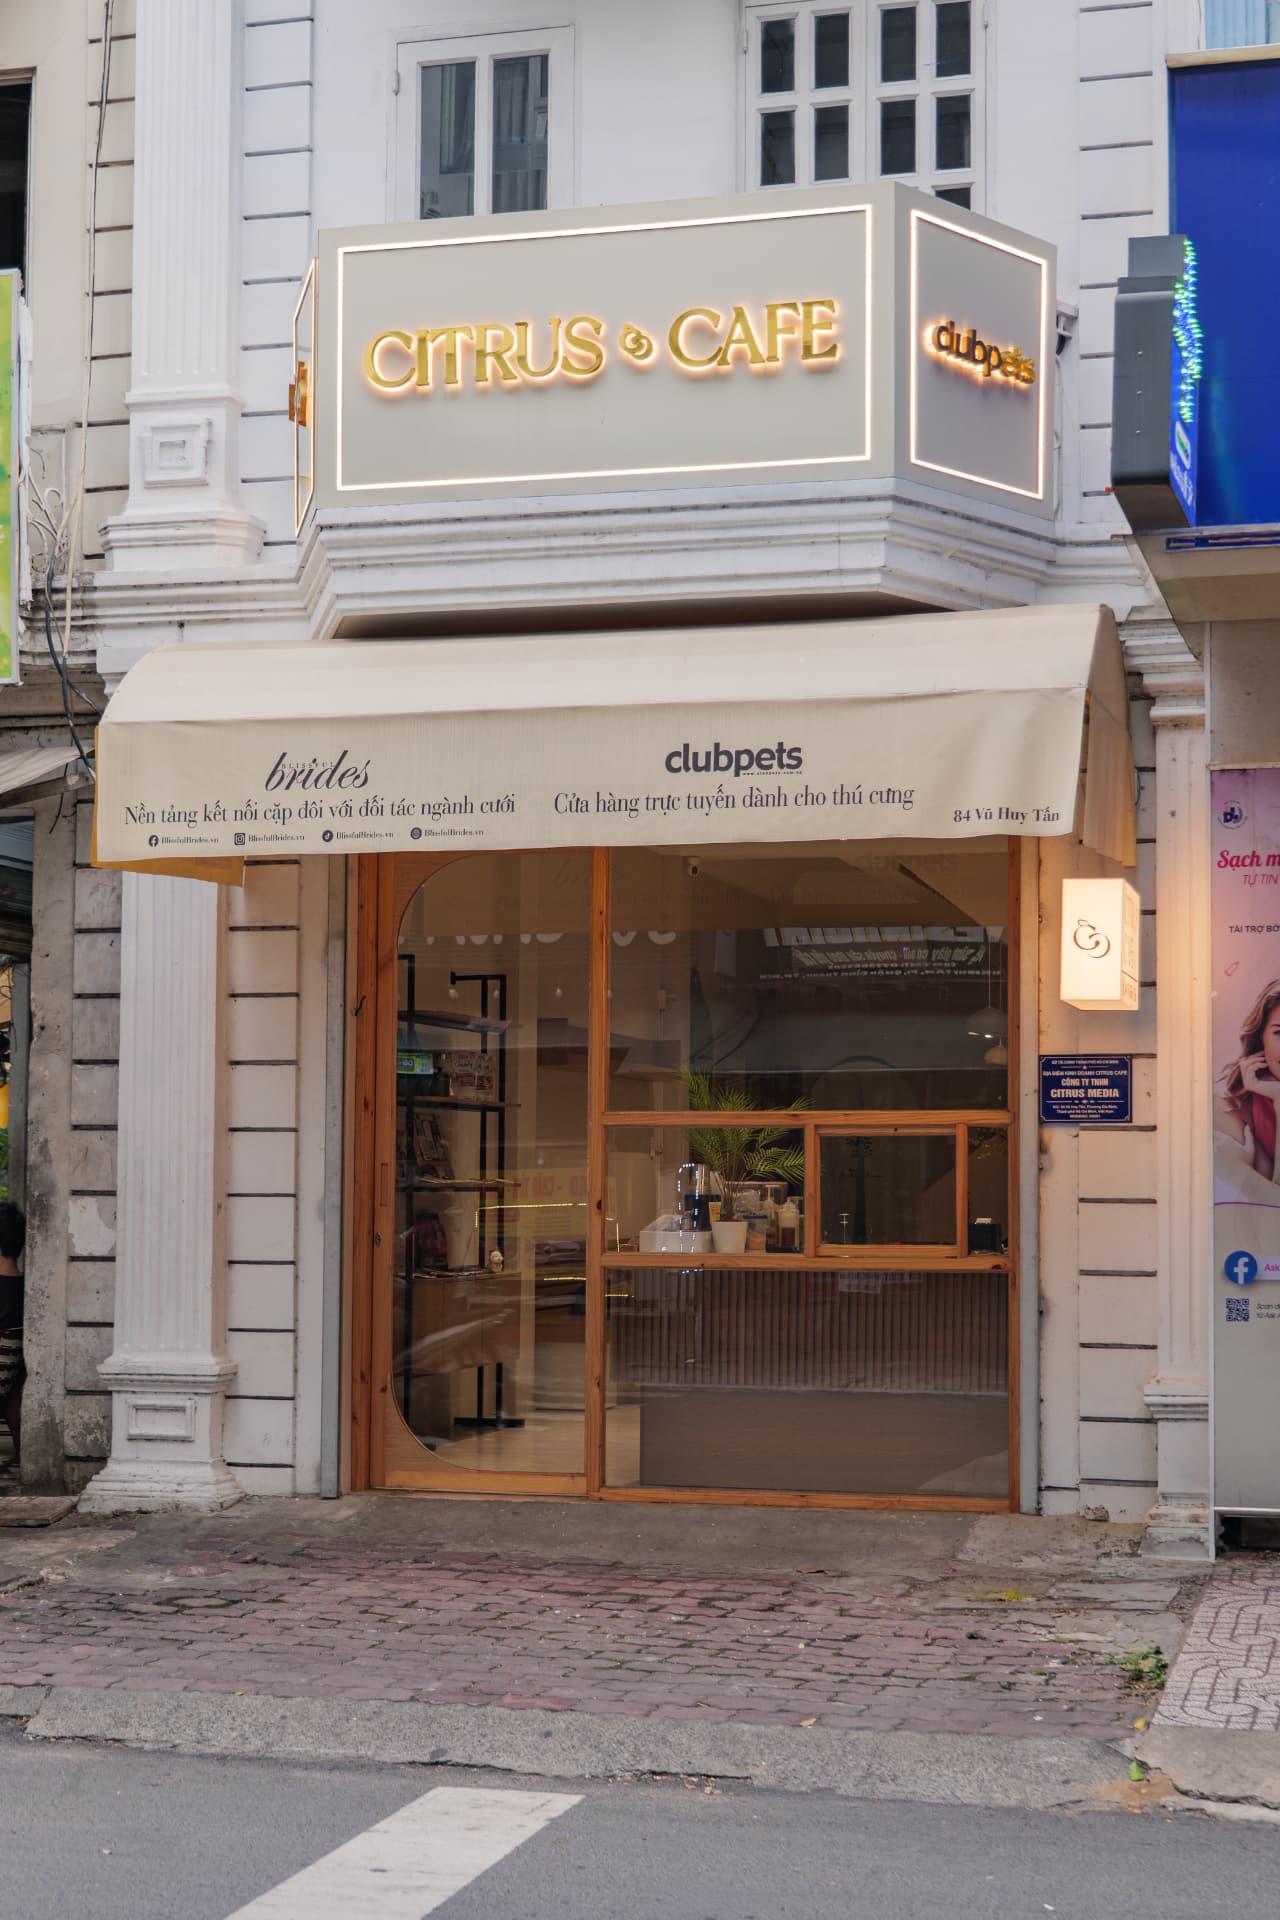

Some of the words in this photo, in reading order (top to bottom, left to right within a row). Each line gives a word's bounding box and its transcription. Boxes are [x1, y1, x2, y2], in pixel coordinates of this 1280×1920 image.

[363, 316, 604, 388] CITRUS
[669, 299, 838, 368] CAFE
[932, 320, 1035, 385] clubpets
[265, 749, 371, 792] brides
[664, 741, 803, 778] clubpets
[124, 802, 156, 825] Nền
[161, 804, 199, 829] tảng
[203, 799, 229, 822] kết
[233, 798, 259, 822] nối
[263, 802, 293, 825] cặp
[297, 799, 324, 820] đôi
[328, 798, 354, 819] với
[358, 794, 385, 818] đối
[390, 798, 416, 817] tác
[421, 794, 475, 822] ngành
[480, 793, 517, 814] cưới
[553, 791, 590, 815] Cửa
[595, 790, 641, 819] hàng
[645, 793, 681, 816] trực
[686, 783, 737, 817] tuyến
[742, 785, 789, 809] dành
[794, 784, 827, 807] cho
[832, 783, 864, 806] thú
[869, 787, 916, 811] cưng
[953, 809, 972, 823] 84
[975, 807, 994, 820] Vũ
[998, 807, 1029, 825] Huy
[1032, 805, 1060, 822] Tấn
[1217, 850, 1263, 872] Sạch
[1260, 873, 1279, 886] TIN
[1050, 1088, 1085, 1098] CITRUS
[1087, 1088, 1120, 1098] MEDIA
[1061, 1077, 1080, 1087] CÔNG
[1081, 1079, 1090, 1087] TY
[1090, 1078, 1109, 1087] TNHH
